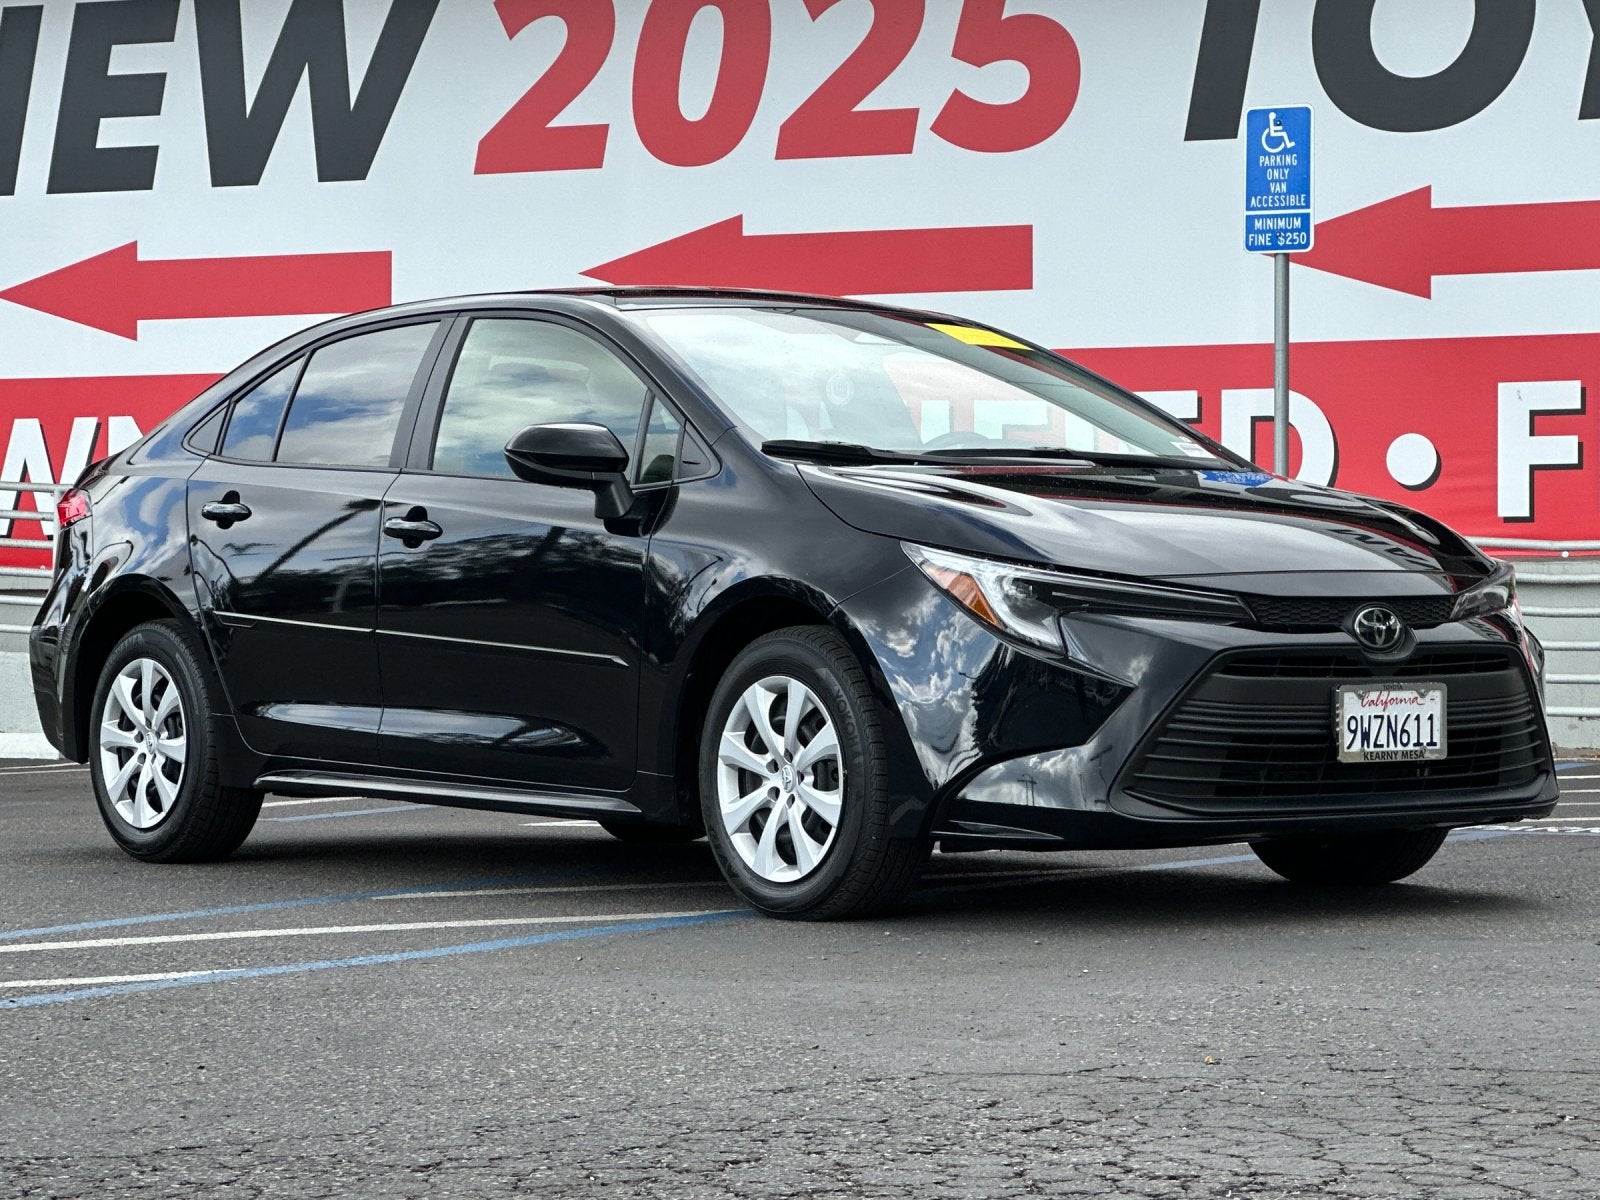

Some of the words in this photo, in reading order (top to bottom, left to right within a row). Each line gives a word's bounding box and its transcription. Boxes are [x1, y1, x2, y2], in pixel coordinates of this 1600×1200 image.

[0, 0, 439, 196] EW
[475, 0, 1081, 175] 2025
[1259, 154, 1298, 167] PARKING
[1266, 168, 1290, 180] ONLY
[1269, 182, 1287, 194] VAN
[1250, 194, 1307, 208] ACCESSIBLE
[1254, 217, 1302, 231] MINIMUM
[1248, 233, 1272, 246] FINE
[1277, 232, 1307, 247] $250
[1360, 690, 1426, 712] California
[1346, 713, 1438, 750] 9WZN611
[1363, 751, 1399, 761] KEARNY
[1401, 750, 1425, 760] MESA
